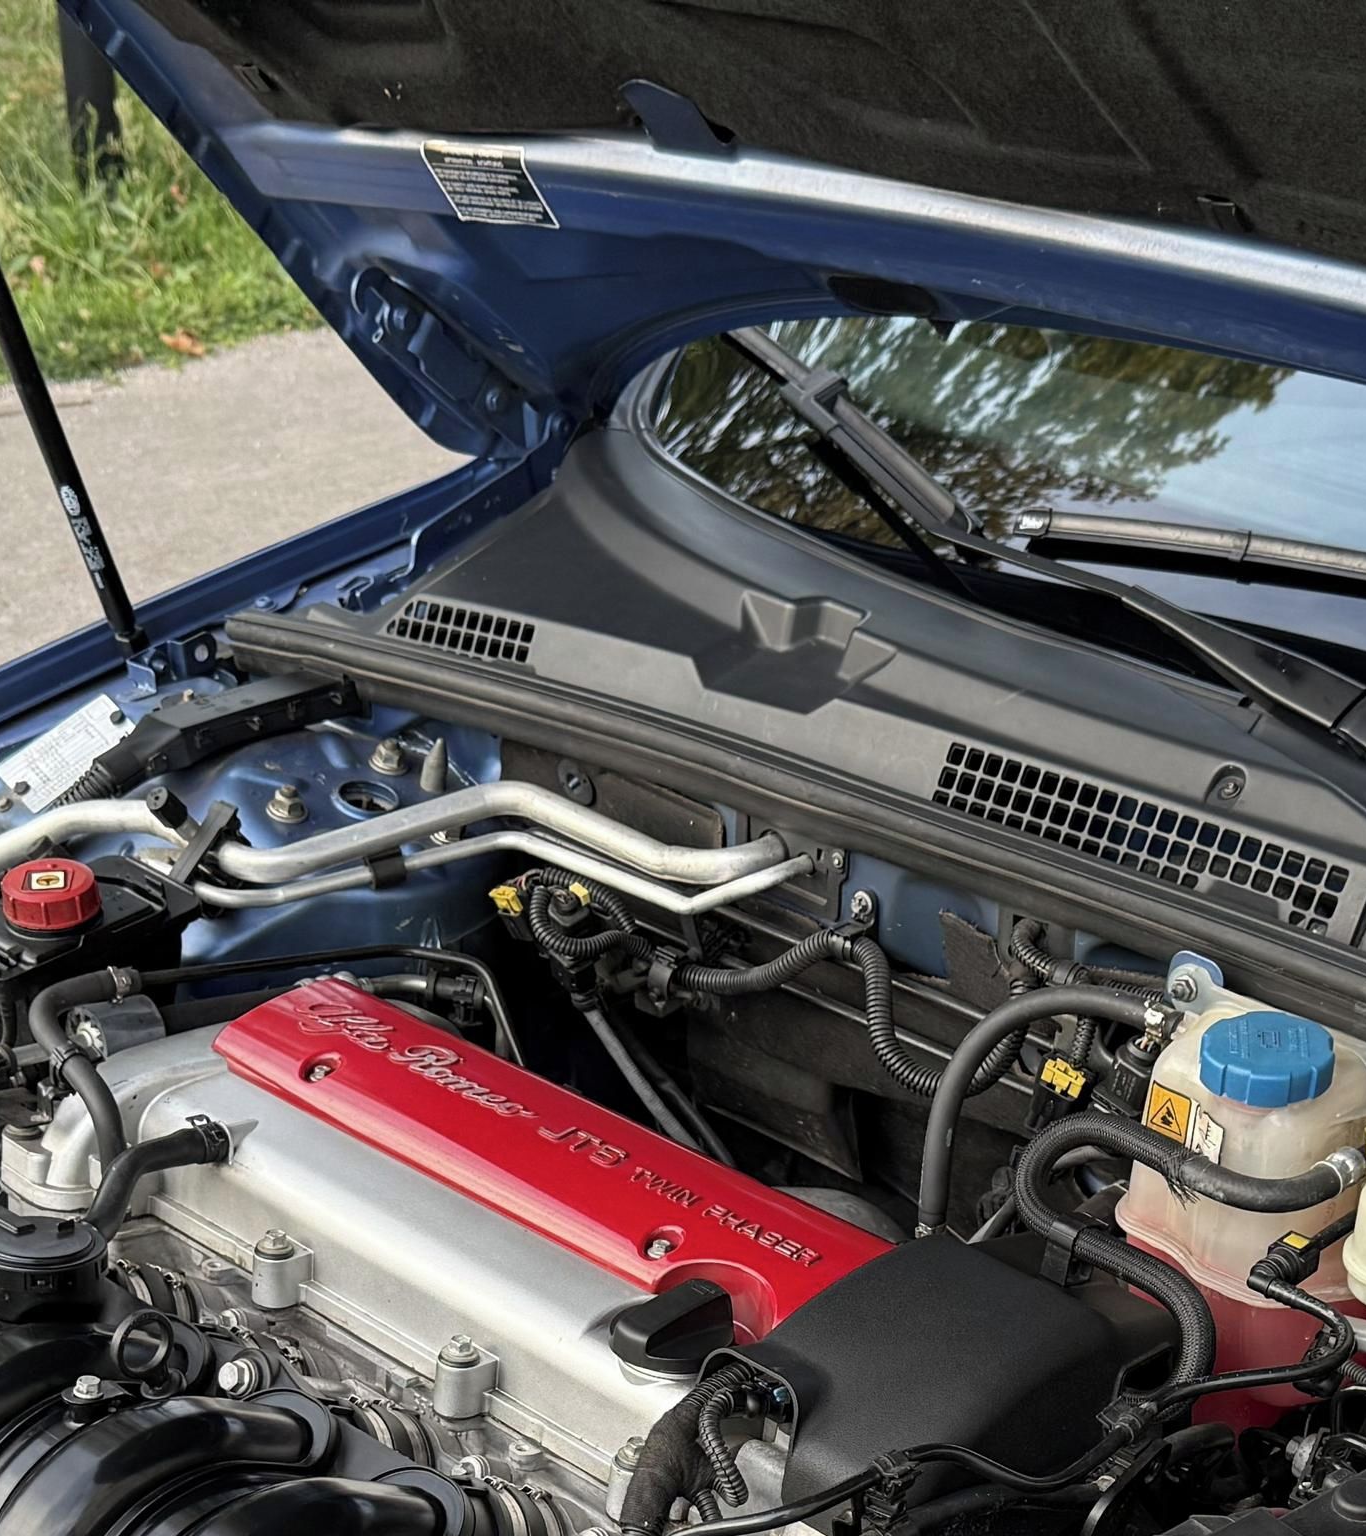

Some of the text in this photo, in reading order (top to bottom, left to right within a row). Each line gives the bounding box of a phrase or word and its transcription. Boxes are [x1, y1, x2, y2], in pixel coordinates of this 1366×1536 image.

[295, 1002, 823, 1268] Alfa Romeo JTS TWIN PHASER
